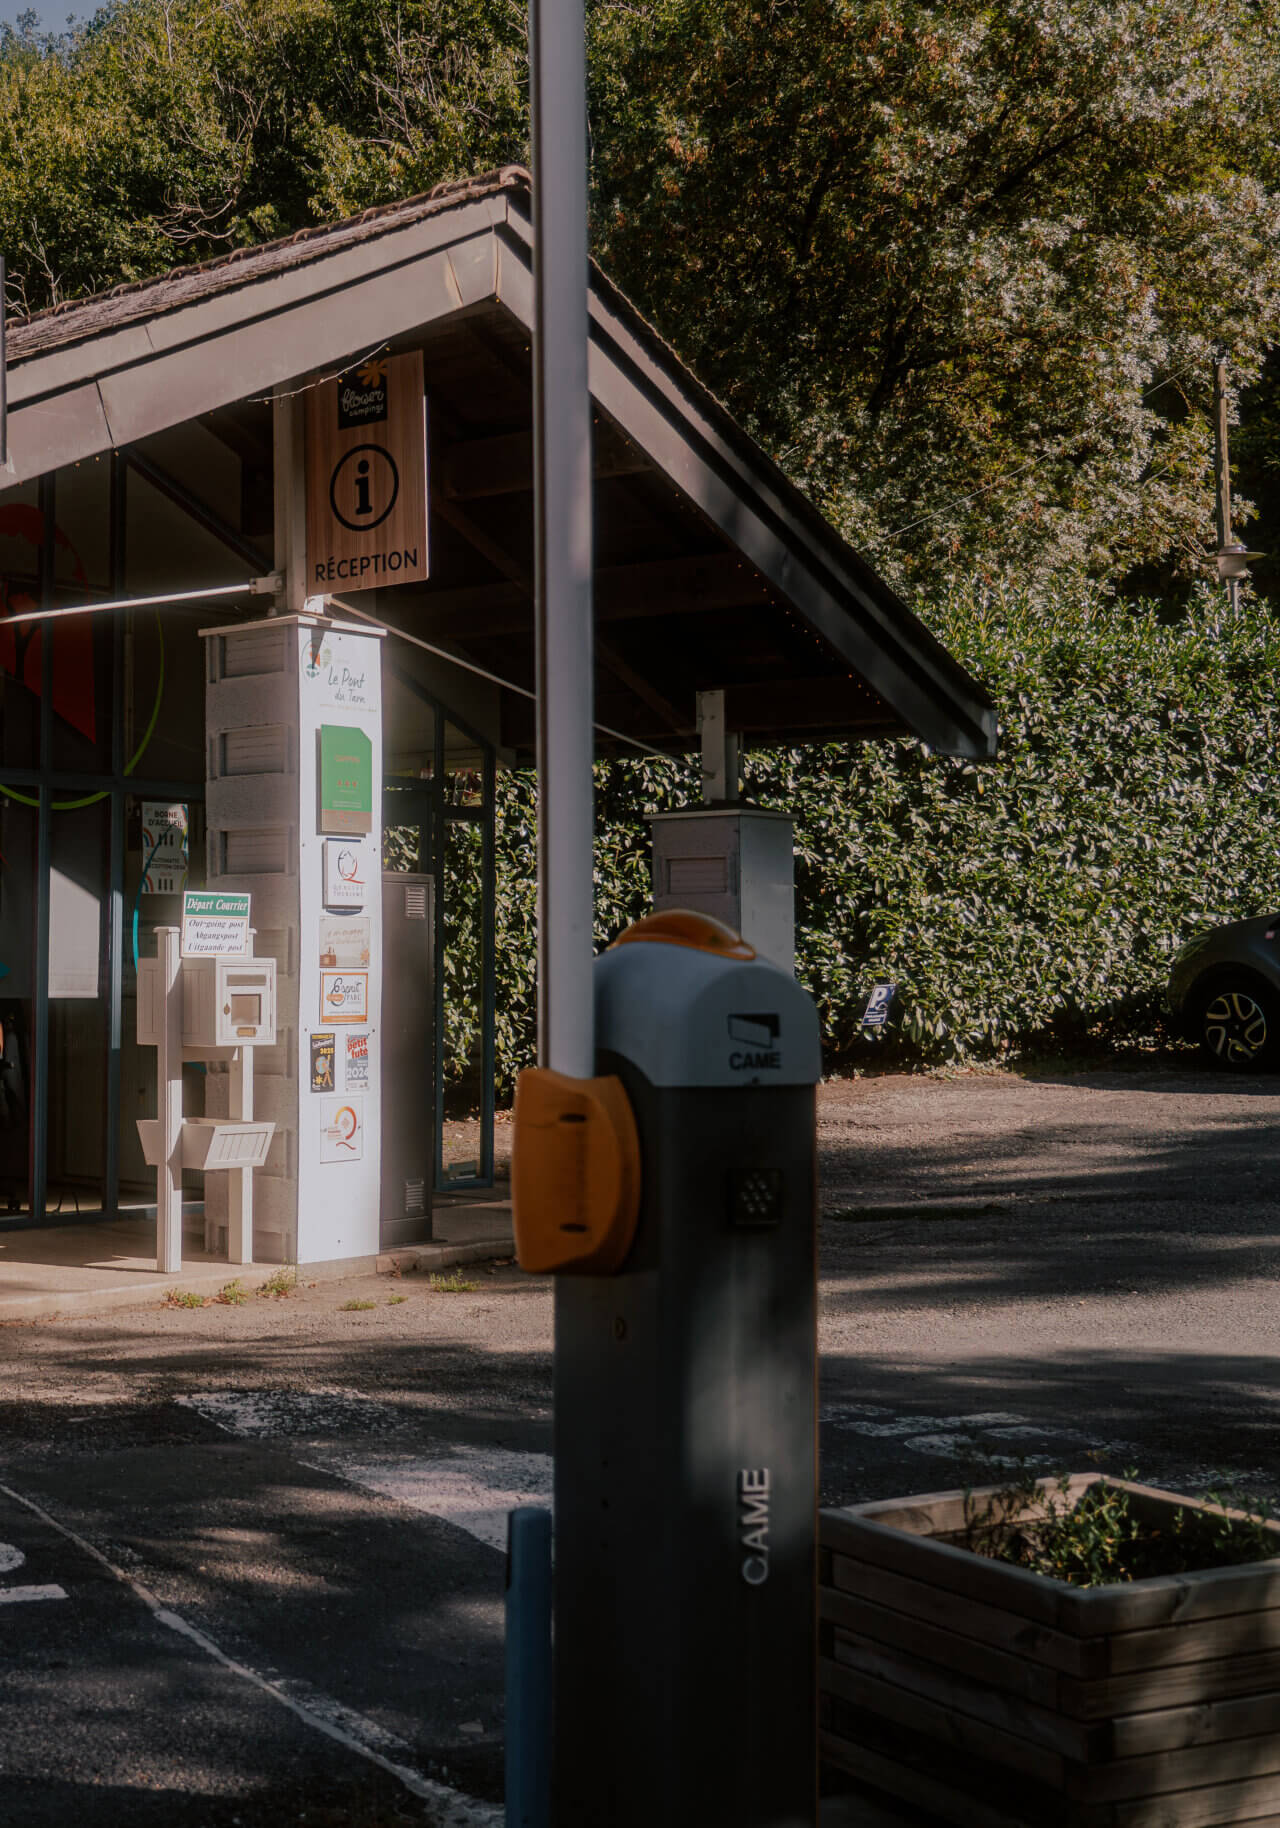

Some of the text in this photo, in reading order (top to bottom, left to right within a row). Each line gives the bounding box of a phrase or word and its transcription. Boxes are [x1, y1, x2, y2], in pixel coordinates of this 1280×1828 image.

[341, 388, 385, 412] flower
[349, 403, 384, 417] campings
[315, 548, 418, 583] RÉCEPTION
[327, 664, 365, 688] Le Pont
[348, 688, 367, 704] Tarn
[187, 898, 248, 912] Départ Courrier
[869, 987, 889, 1009] P
[347, 1037, 368, 1053] petit
[728, 1052, 782, 1070] CAME
[741, 1468, 769, 1586] CAME
